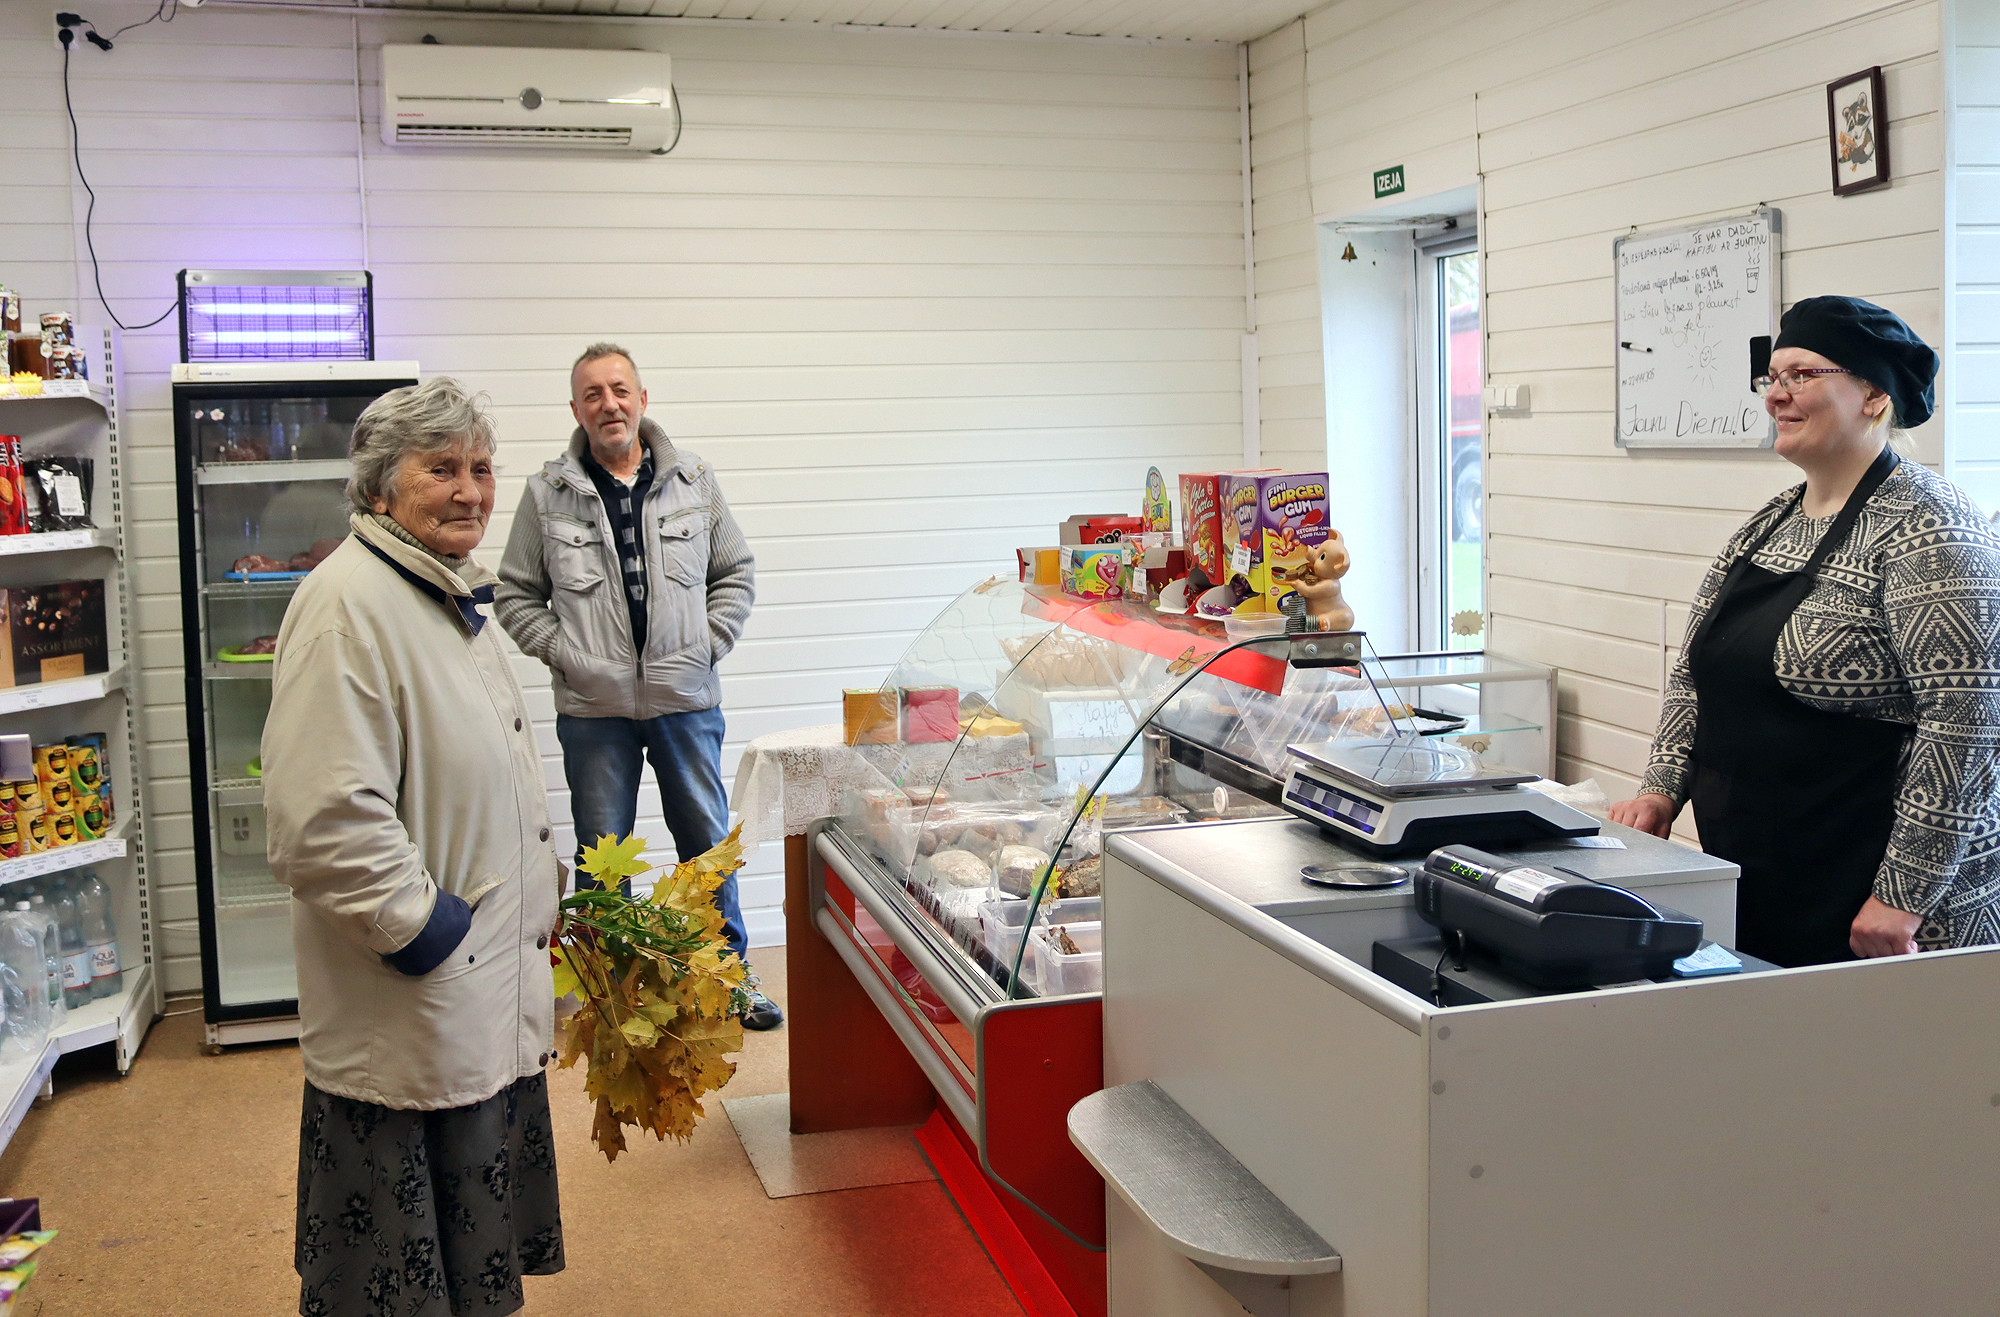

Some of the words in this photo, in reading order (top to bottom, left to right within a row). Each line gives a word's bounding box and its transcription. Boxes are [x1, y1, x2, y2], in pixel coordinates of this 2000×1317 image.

[1377, 172, 1402, 192] IZEJA
[1707, 229, 1721, 242] VAR
[1728, 221, 1760, 237] DABŪT
[1686, 245, 1716, 258] KAFIJU
[1721, 241, 1730, 251] AR
[1624, 307, 1636, 321] Lai
[1621, 404, 1667, 437] Jauku
[1232, 485, 1257, 509] BURGER
[1267, 482, 1287, 499] FINI
[1269, 484, 1325, 511] BURGER
[1240, 505, 1252, 523] GUM
[1284, 500, 1313, 517] GUM
[21, 636, 99, 657] ASSORTMENT
[92, 950, 115, 962] AQUA
